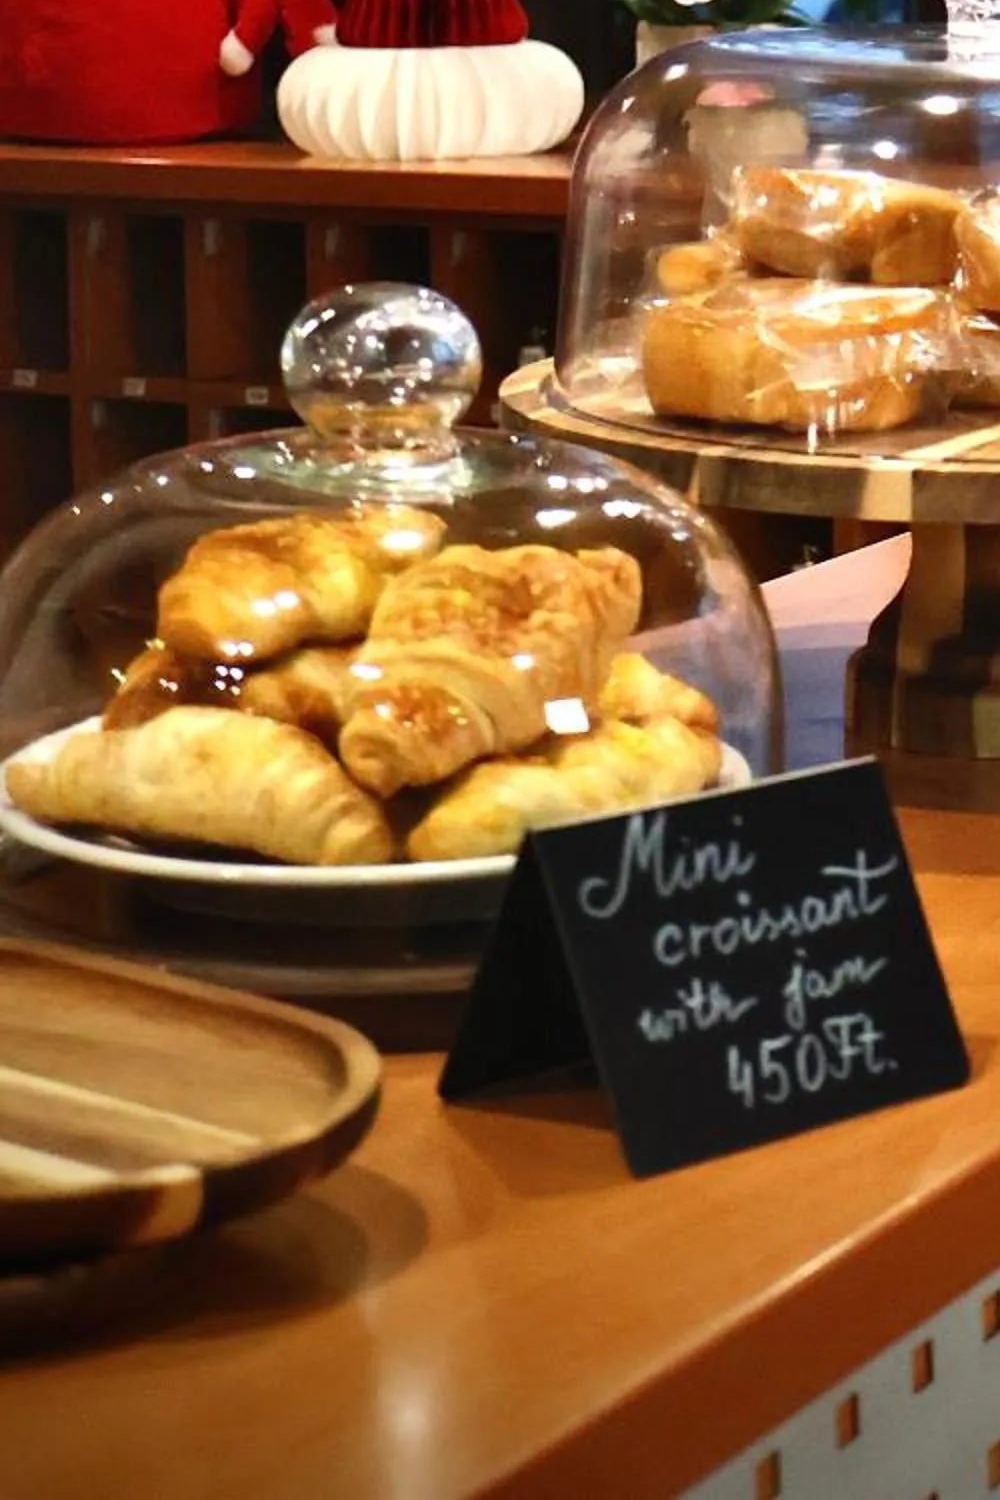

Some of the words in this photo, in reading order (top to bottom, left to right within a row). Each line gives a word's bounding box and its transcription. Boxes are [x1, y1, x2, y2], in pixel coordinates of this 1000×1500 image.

[578, 811, 757, 918] Mini
[653, 849, 898, 967] croissant
[638, 977, 759, 1043] with
[782, 949, 888, 1029] jam
